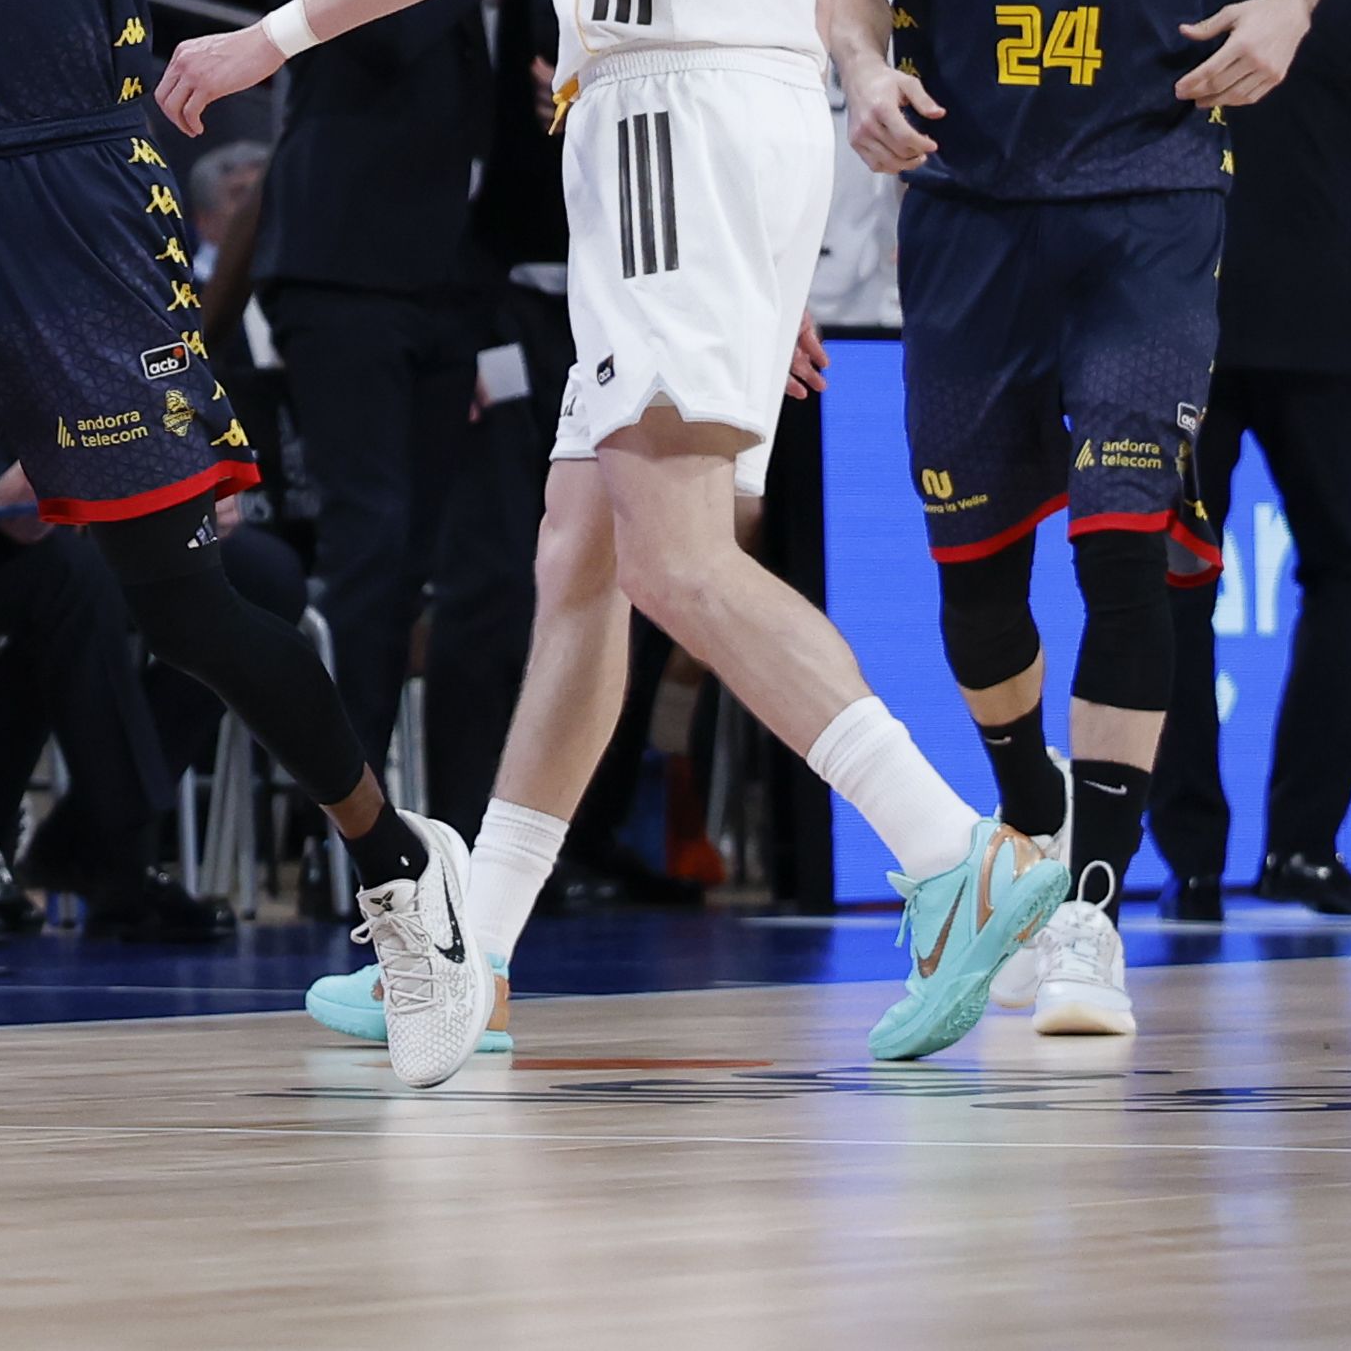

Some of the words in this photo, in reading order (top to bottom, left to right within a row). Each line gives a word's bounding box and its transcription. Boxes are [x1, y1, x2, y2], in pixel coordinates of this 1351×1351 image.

[994, 4, 1103, 87] 24
[149, 354, 180, 376] acb
[76, 409, 142, 432] andorra
[80, 424, 149, 449] telecom
[1101, 438, 1161, 456] andorra
[1101, 453, 1163, 470] telecom
